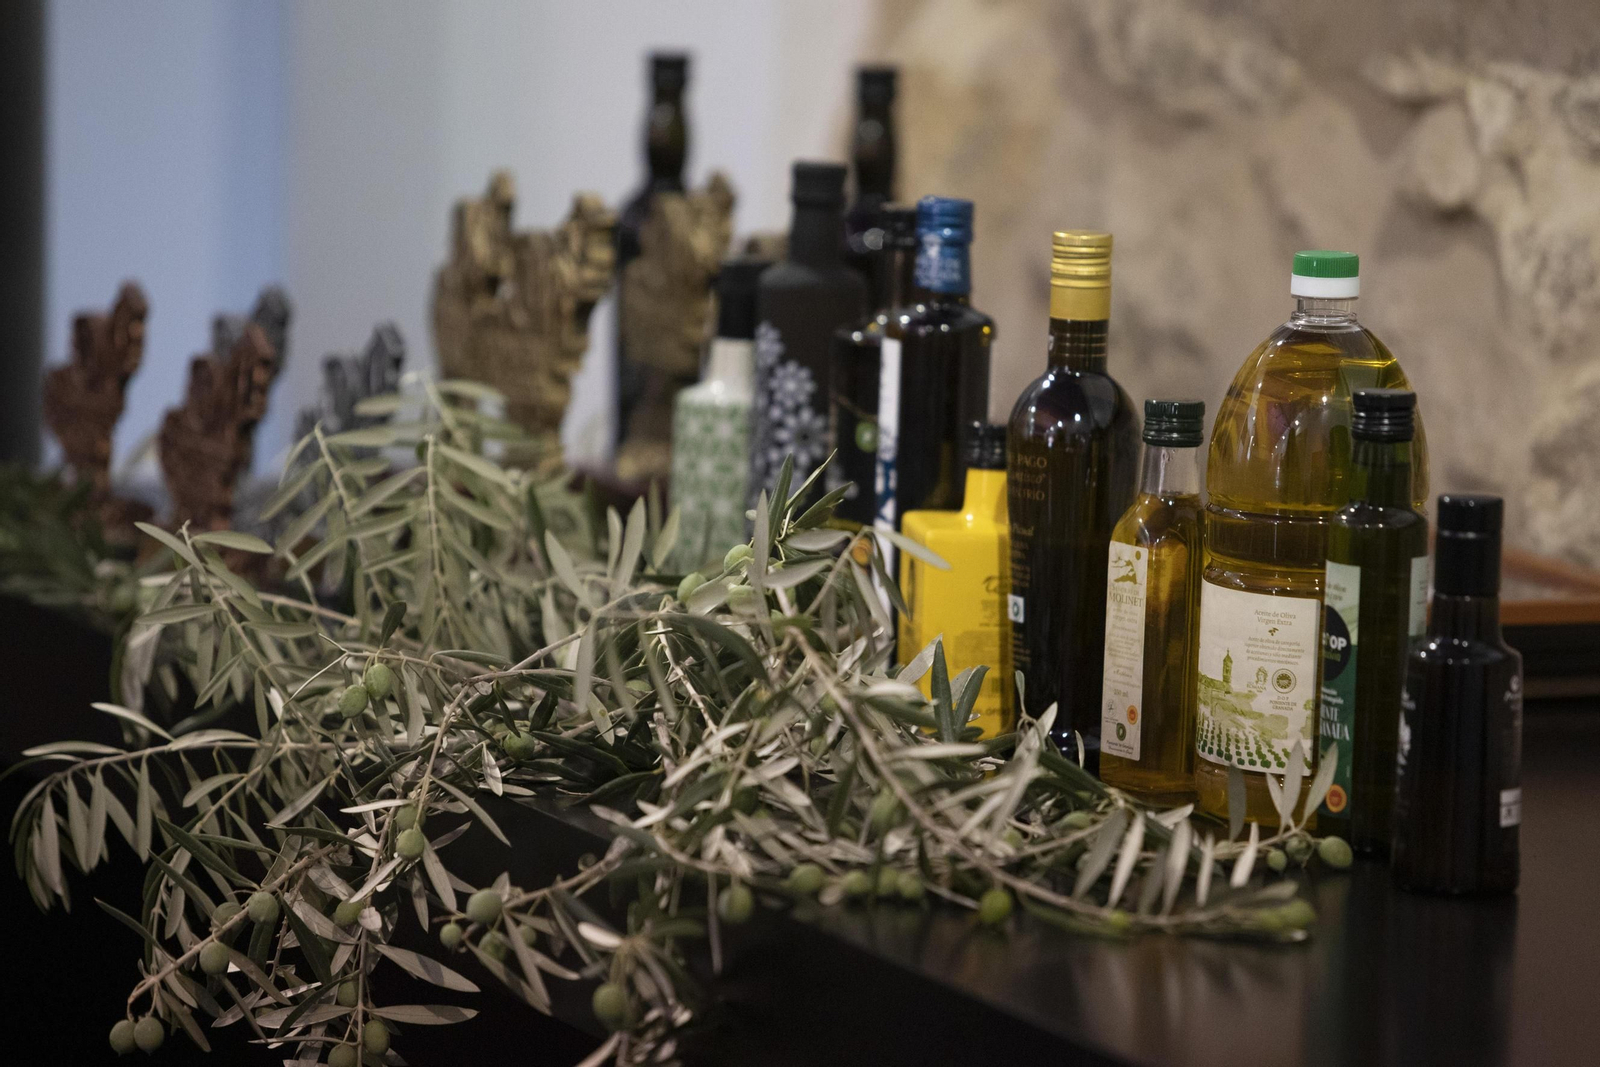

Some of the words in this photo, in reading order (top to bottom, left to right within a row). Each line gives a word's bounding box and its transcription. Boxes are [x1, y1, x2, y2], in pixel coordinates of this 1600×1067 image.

[1109, 592, 1144, 607] MOLINET
[1254, 609, 1271, 617] Aceite
[1280, 612, 1297, 620] Oliva
[1257, 616, 1276, 625] Virgen
[1277, 618, 1293, 626] Extra
